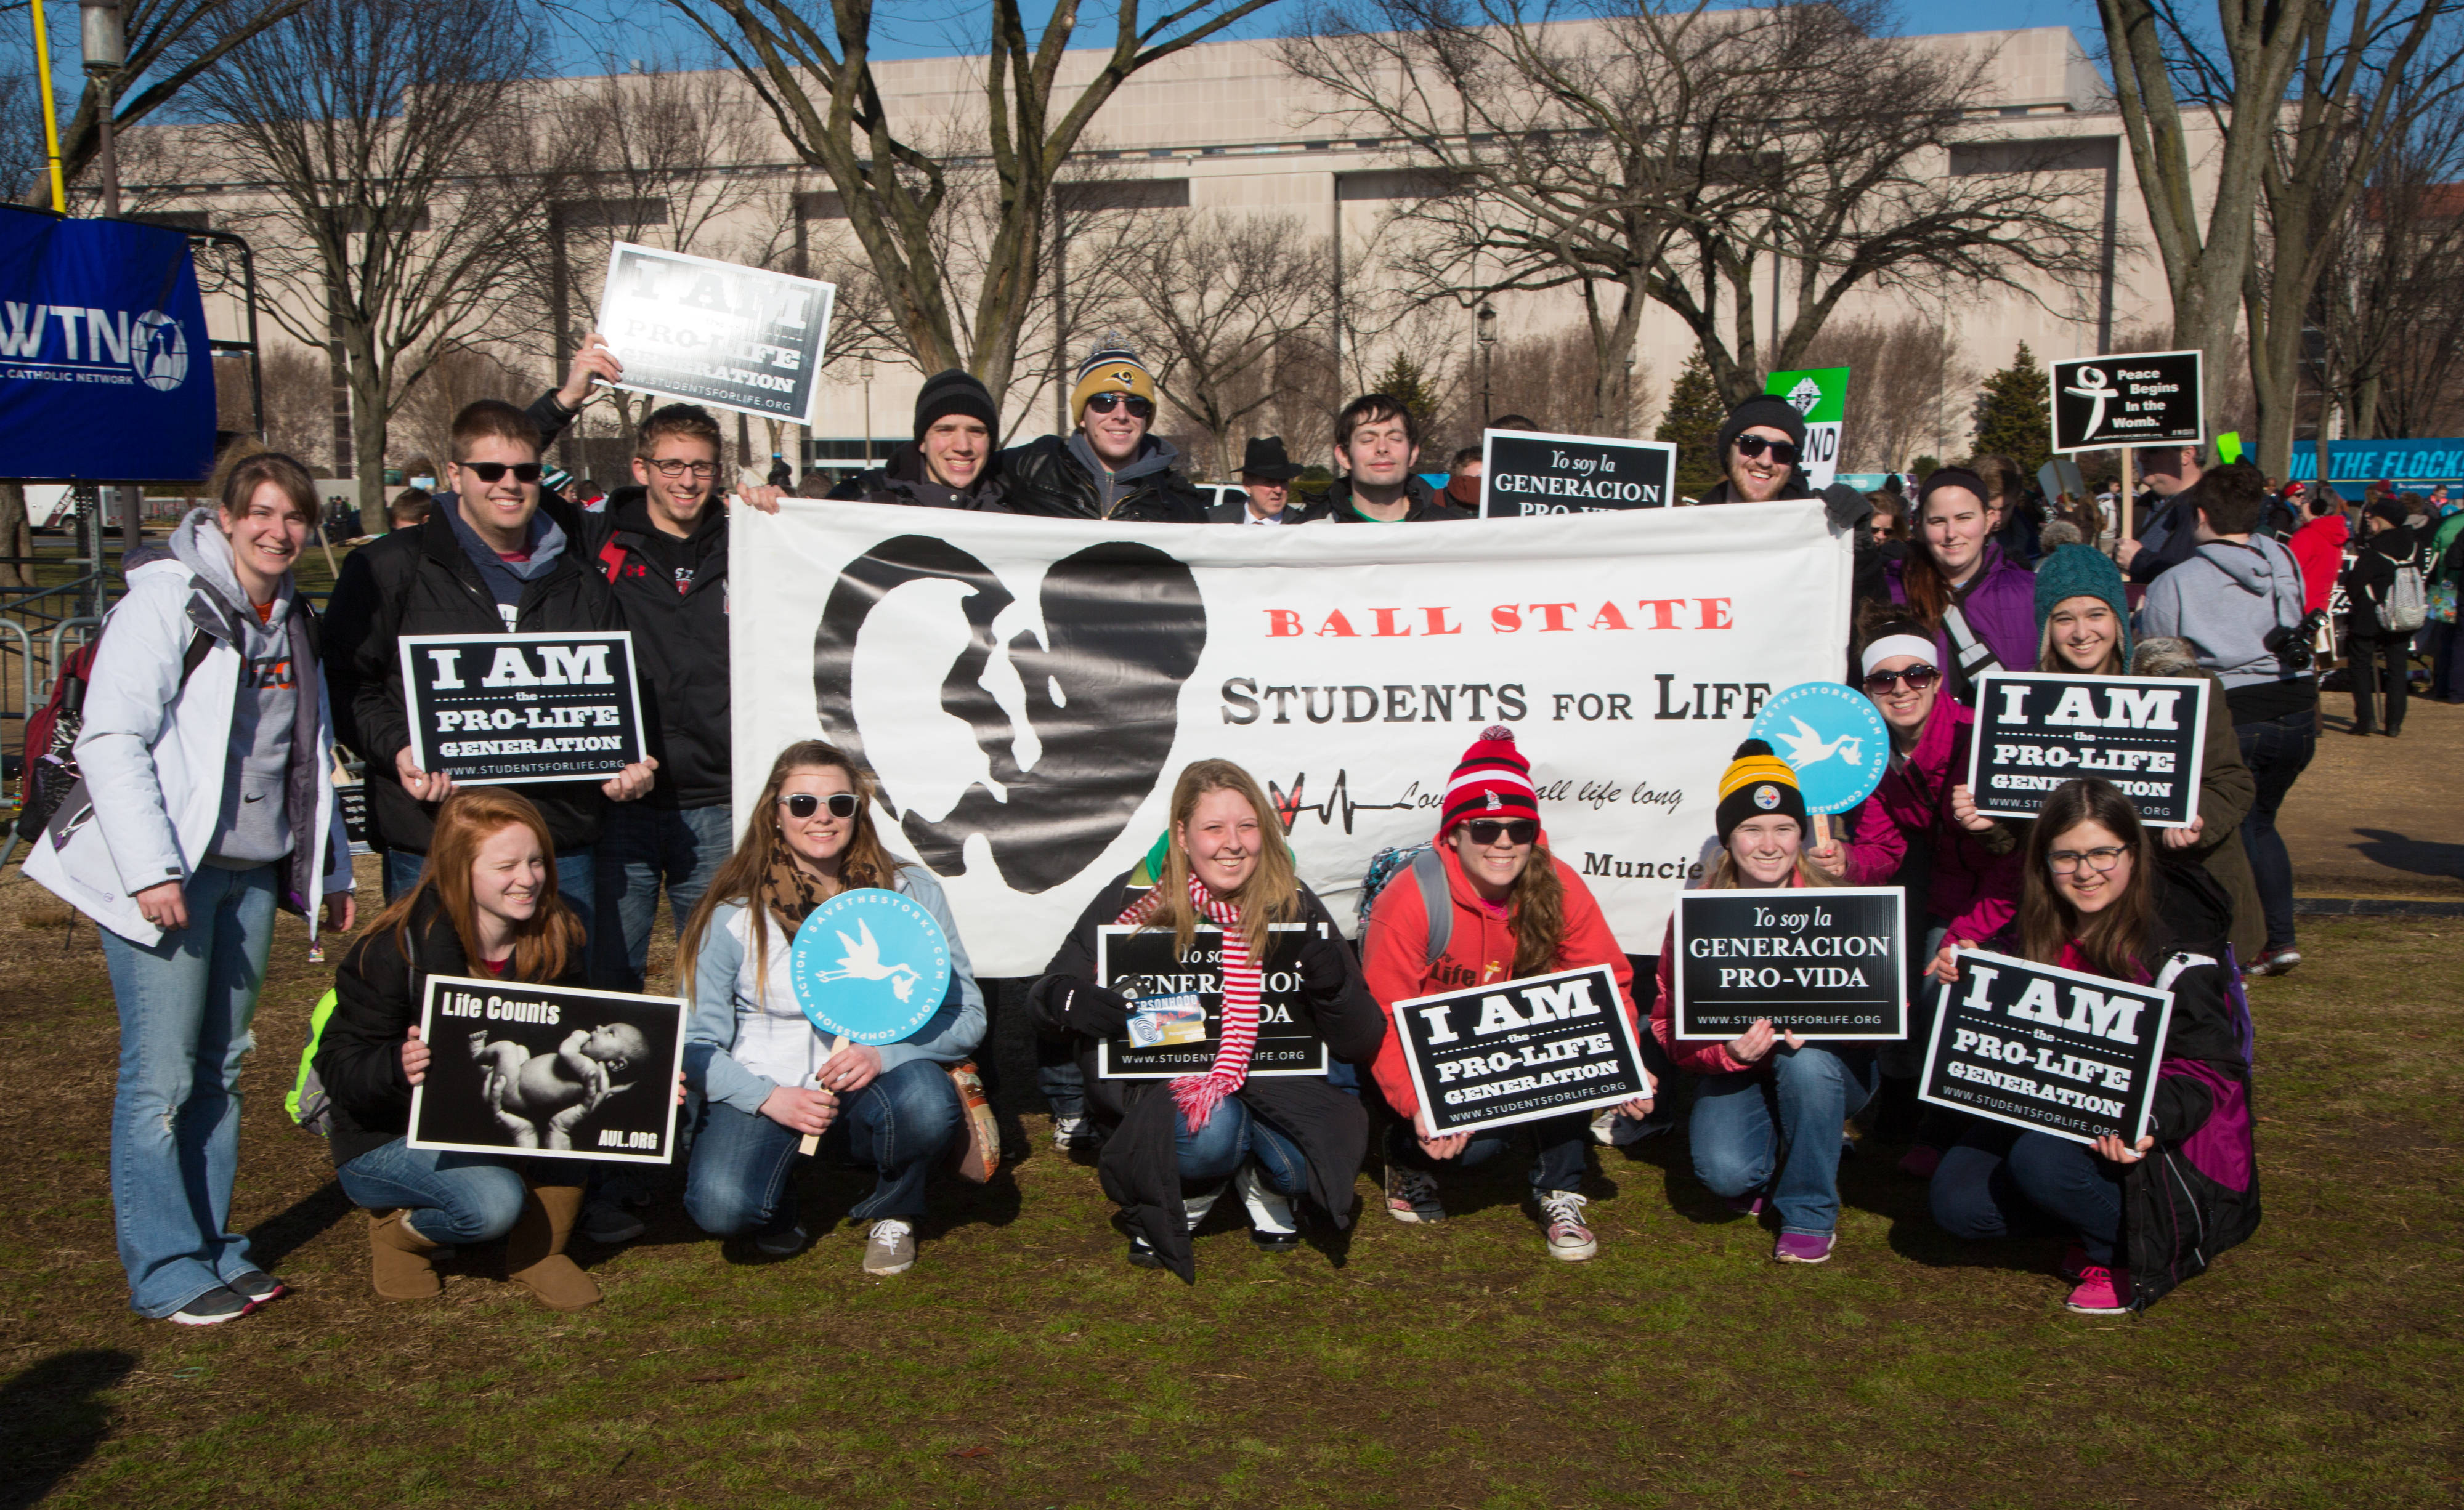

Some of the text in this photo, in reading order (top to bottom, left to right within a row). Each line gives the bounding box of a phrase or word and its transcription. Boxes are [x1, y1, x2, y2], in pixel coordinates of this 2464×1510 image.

[679, 270, 811, 329] AM
[7, 369, 73, 381] CATHOLIC
[76, 373, 134, 385] NETWORK
[2117, 369, 2161, 381] Peace
[2130, 382, 2179, 396] Begins
[2125, 400, 2166, 412] In the
[2112, 416, 2160, 428] Womb.
[1550, 450, 1615, 477] Yo soy la
[2330, 451, 2378, 478] THE
[1494, 473, 1661, 503] GENERACION
[1263, 597, 1734, 637] BALL STATE
[428, 645, 615, 690] I AM
[515, 692, 538, 702] the
[1220, 677, 1528, 725] STUDENTS
[1996, 685, 2181, 730] I AM
[435, 705, 620, 732] PRO-LIFE
[439, 735, 622, 757] GENERATION
[2073, 731, 2096, 741] the
[1756, 687, 1884, 814] AVETHESTORKS.COM LOVE COMPASSI
[1992, 744, 2177, 773] PRO-LIFE
[442, 759, 626, 776] WWW.STUDENTSFORLIFE.ORG
[1578, 780, 1621, 811] life
[1631, 779, 1684, 815] long
[1583, 852, 1704, 880] Muncie
[1754, 906, 1832, 934] Yo soy la
[1206, 950, 1223, 970] so
[1689, 936, 1891, 958] GENERACION
[796, 950, 811, 998] ACTION
[1430, 961, 1477, 987] Life
[1719, 967, 1870, 988] PRO-VIDA
[441, 991, 561, 1025] Life Counts
[909, 998, 936, 1025] LOVE
[1419, 979, 1602, 1045] I AM
[1962, 964, 2146, 1045] I AM
[815, 1011, 896, 1040] COMPASSION
[1507, 1033, 1531, 1044] the
[2033, 1028, 2056, 1043] the
[1435, 1032, 1614, 1083] PRO-LIFE
[1952, 1028, 2133, 1092] PRO-LIFE
[1443, 1060, 1620, 1105] GENERATION
[1947, 1060, 2126, 1119] GENERATION
[1449, 1081, 1627, 1123] WWW.STUDENTSFORLIFE.ORG
[598, 1129, 658, 1150] AUL.ORG
